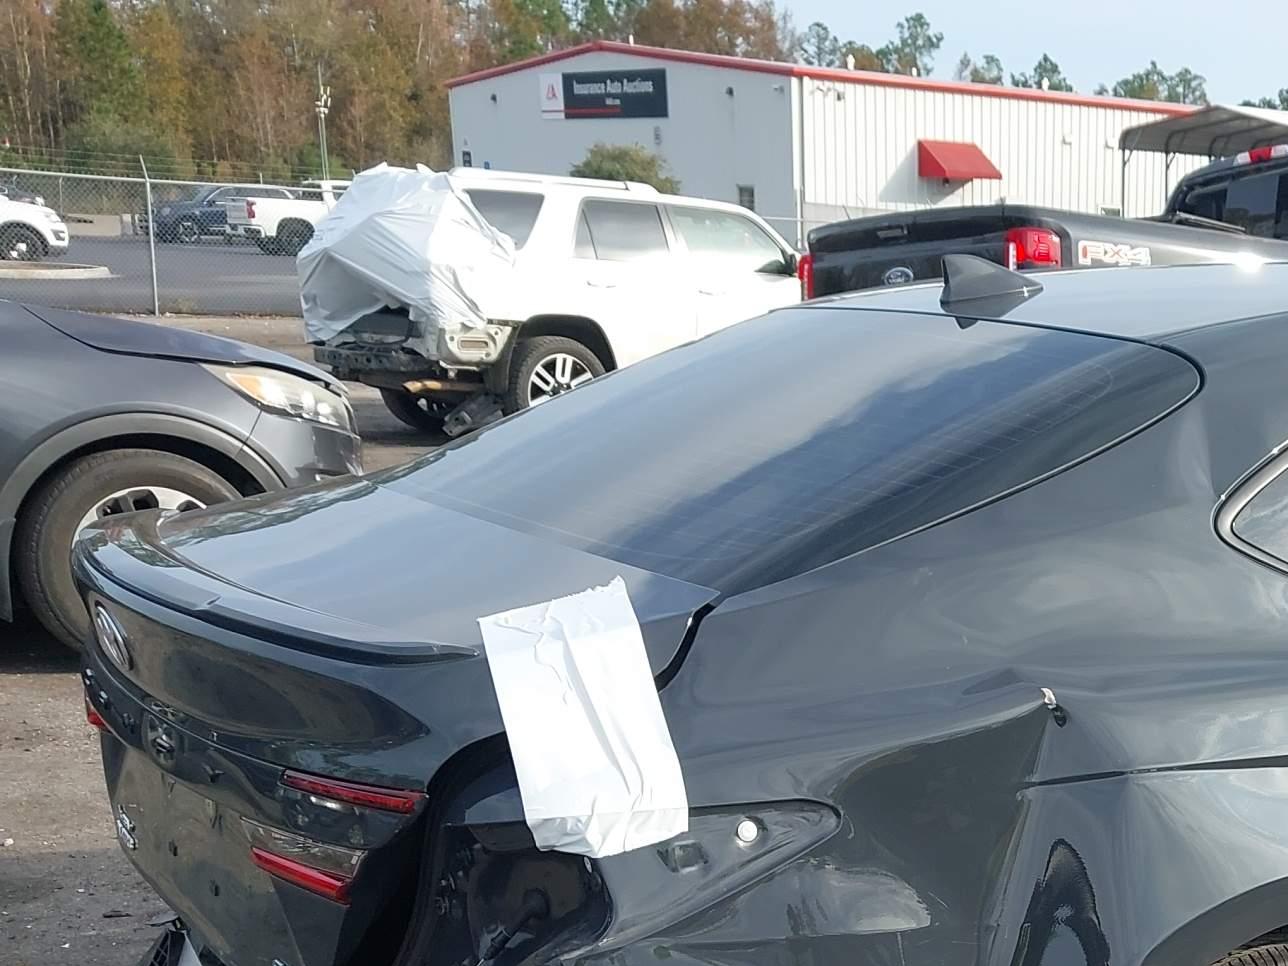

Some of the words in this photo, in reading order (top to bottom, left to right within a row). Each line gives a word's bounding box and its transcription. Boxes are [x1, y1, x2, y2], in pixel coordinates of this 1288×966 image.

[573, 80, 606, 95] Insurance
[606, 78, 622, 93] Auto
[623, 78, 654, 93] Auctions
[1079, 240, 1152, 266] FX4
